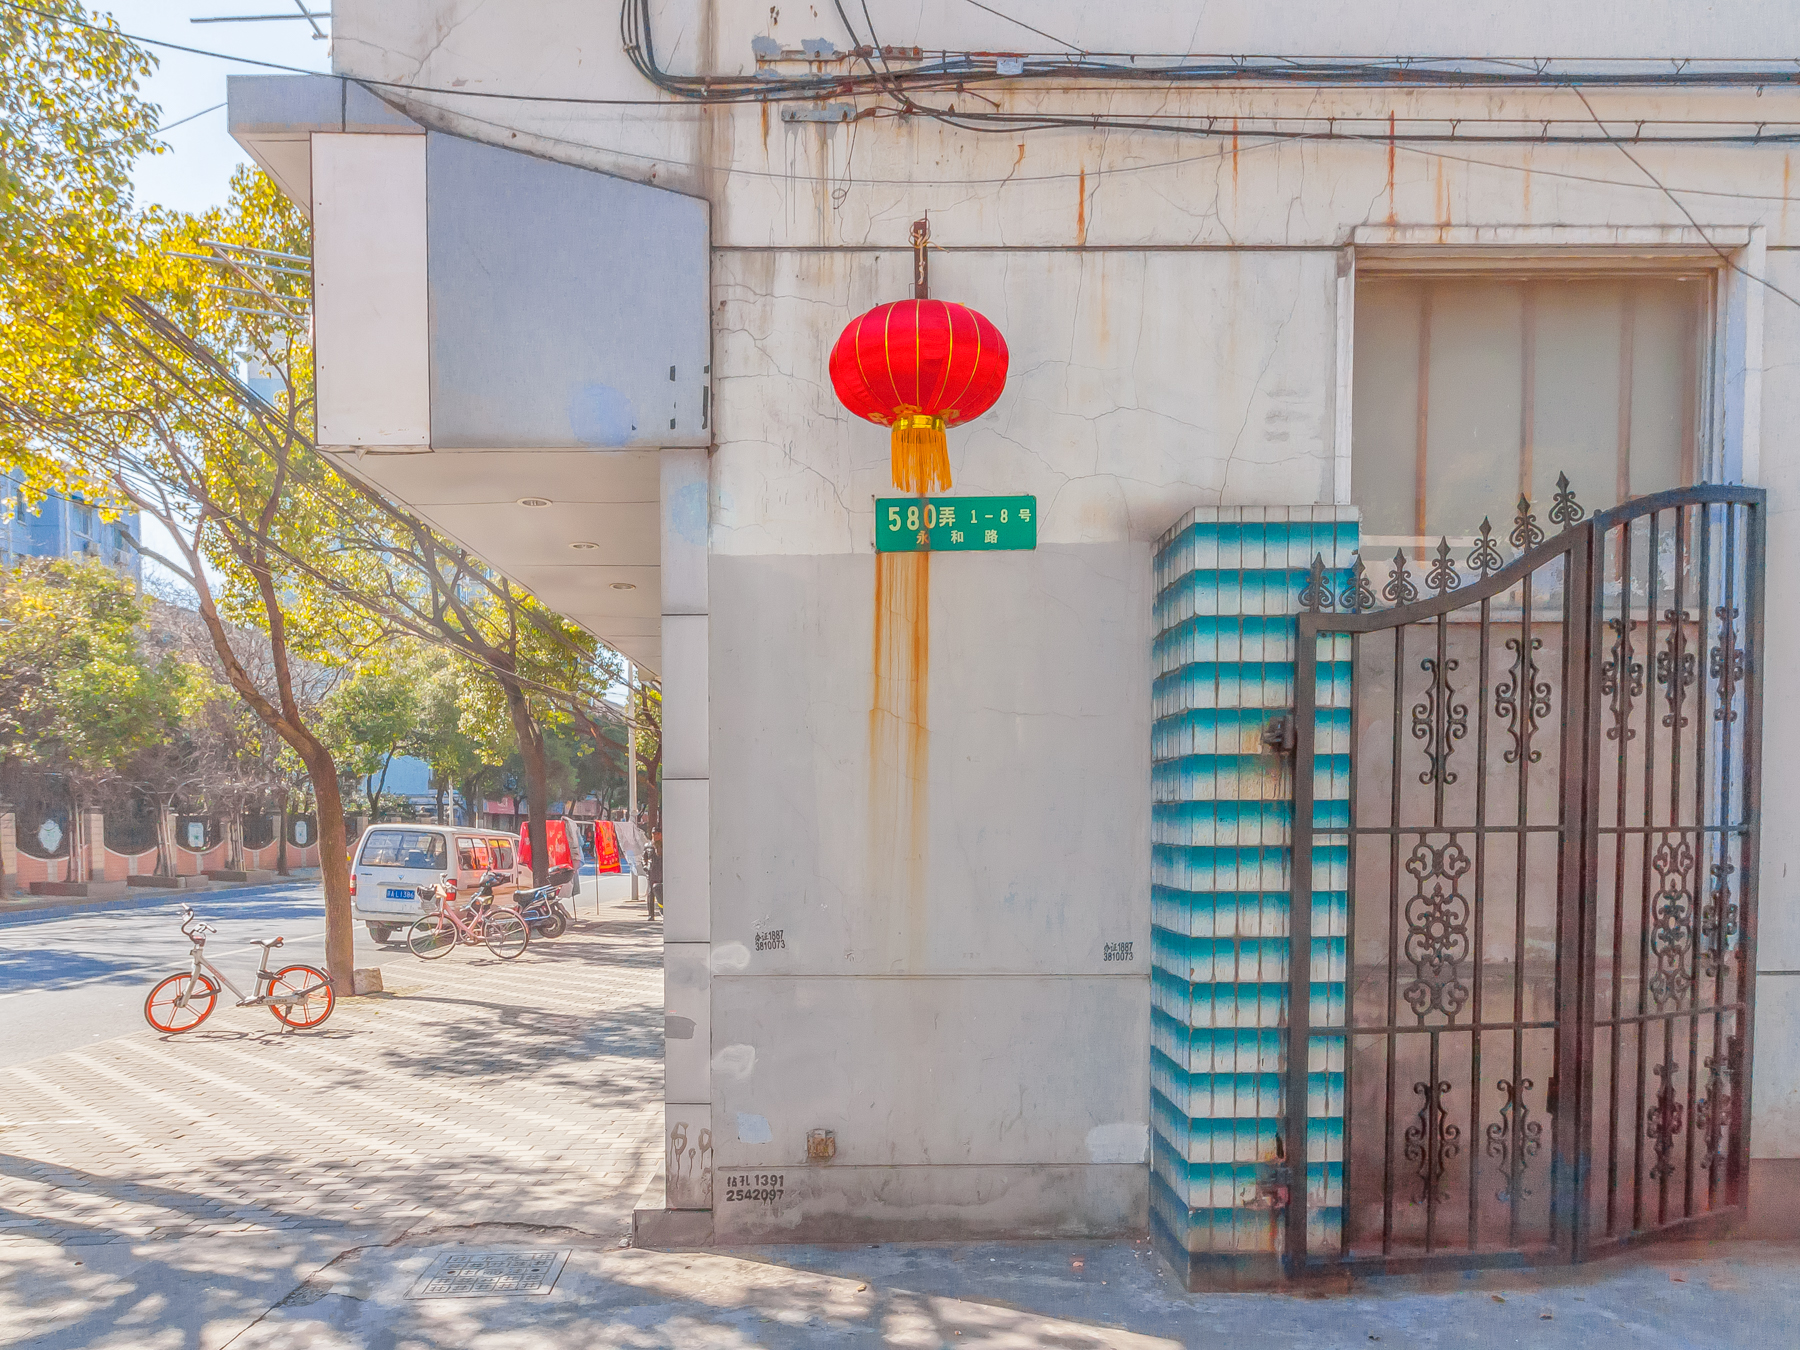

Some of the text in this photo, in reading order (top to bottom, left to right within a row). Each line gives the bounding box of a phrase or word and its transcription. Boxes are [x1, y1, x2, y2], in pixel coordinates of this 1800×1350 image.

[888, 504, 956, 532] 580弄
[916, 529, 998, 545] 永和路
[755, 939, 786, 951] 3810073
[1103, 951, 1134, 961] 3810073
[754, 1174, 784, 1187] 1391
[725, 1188, 785, 1202] 2542097
